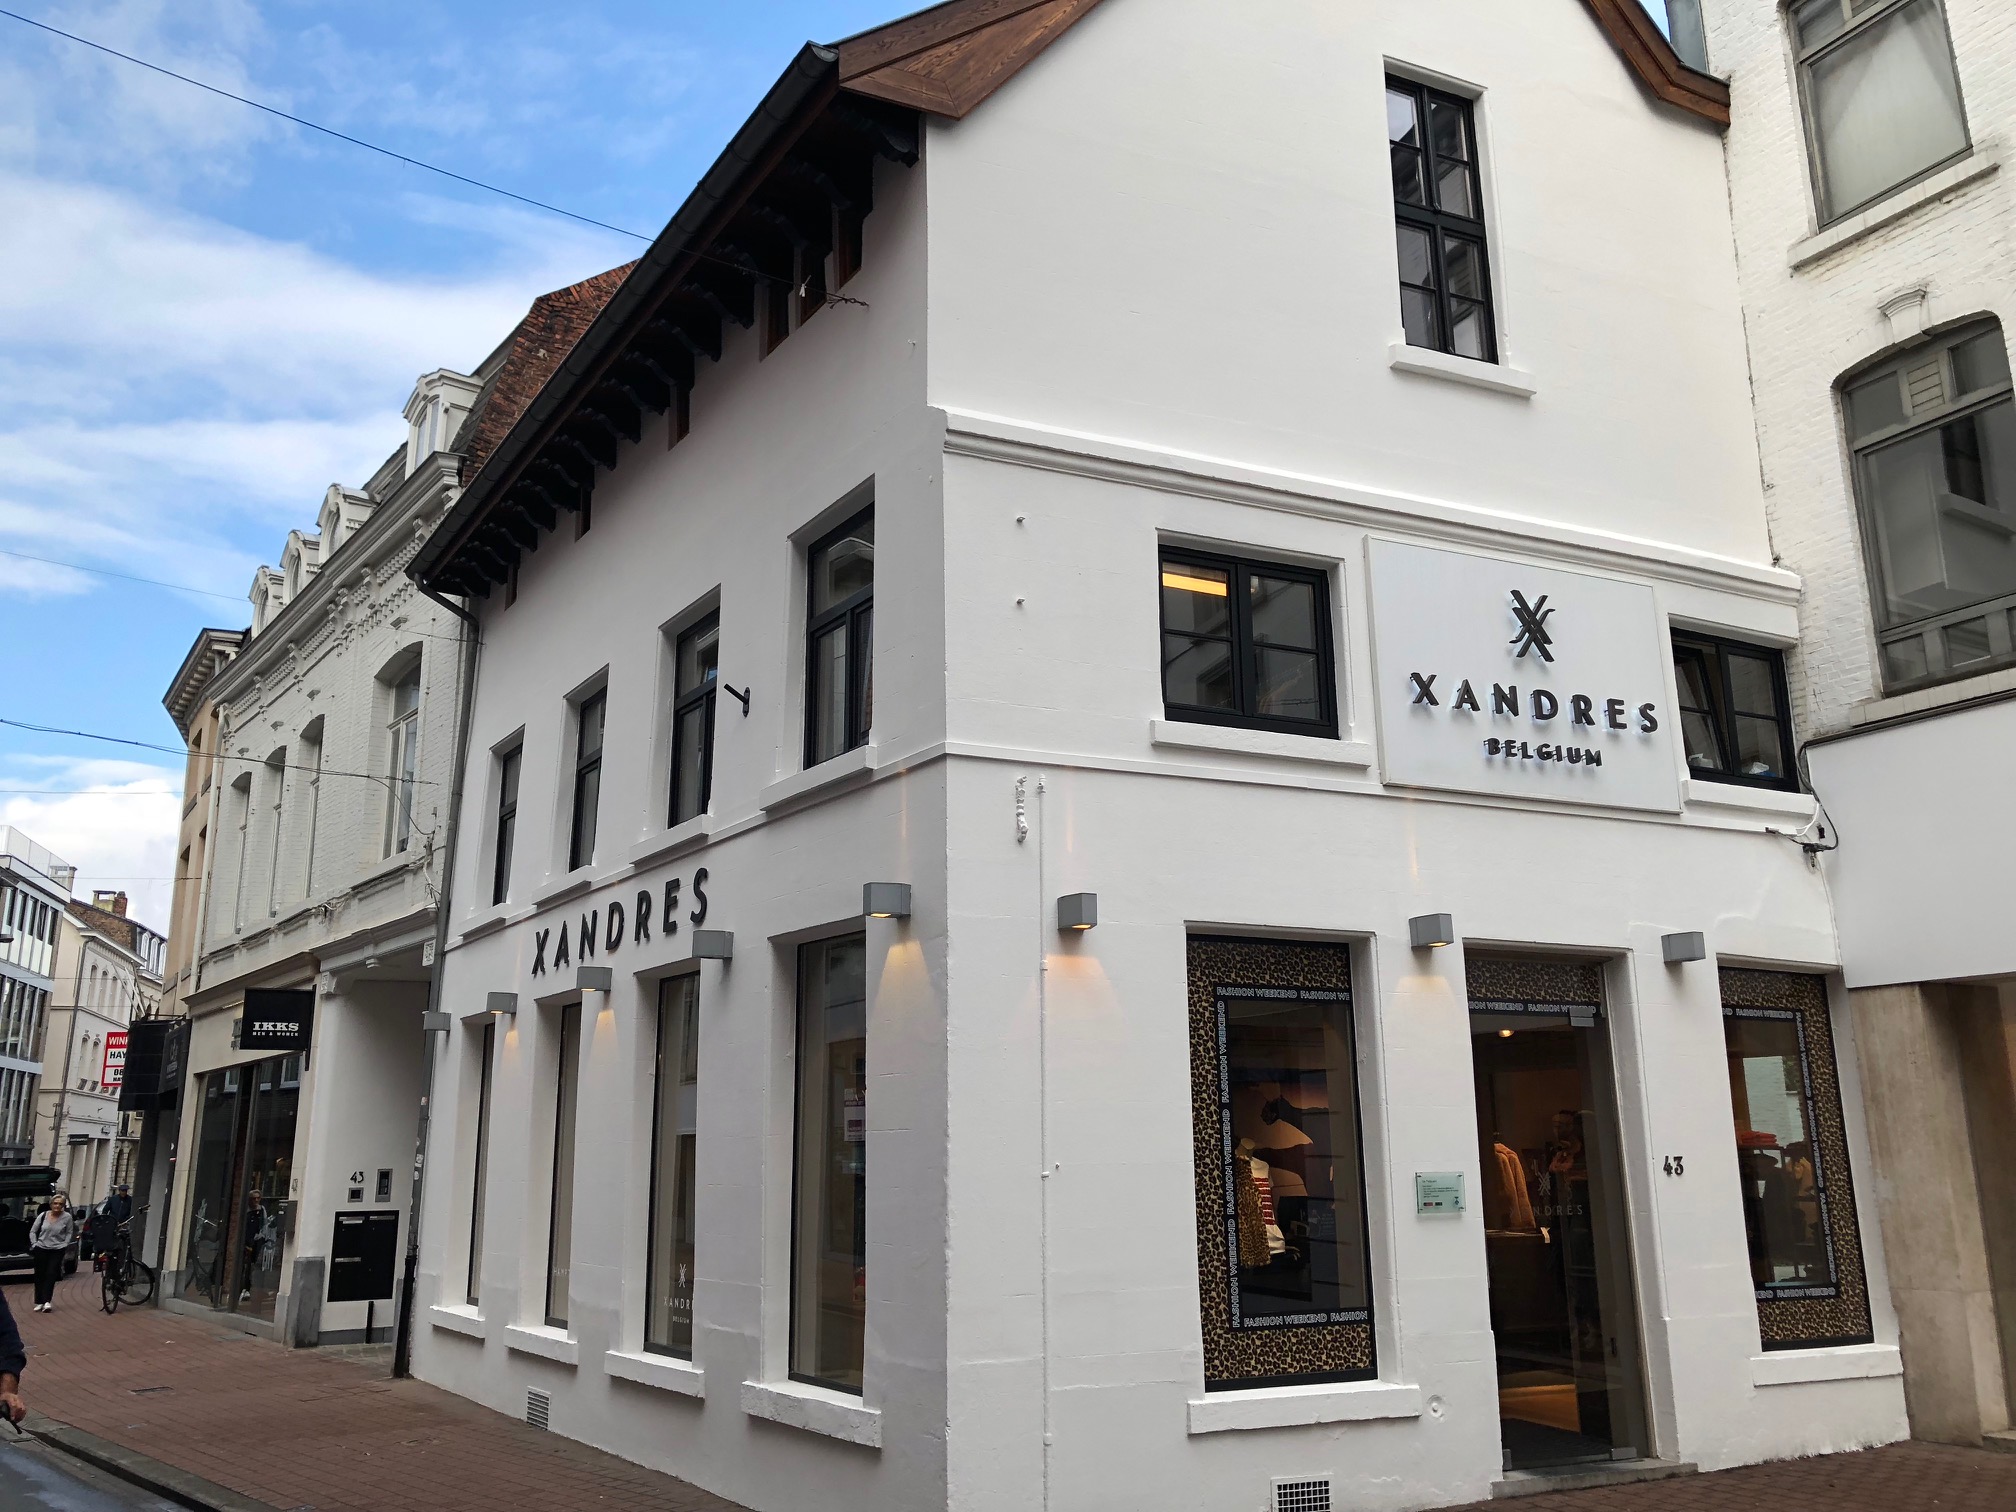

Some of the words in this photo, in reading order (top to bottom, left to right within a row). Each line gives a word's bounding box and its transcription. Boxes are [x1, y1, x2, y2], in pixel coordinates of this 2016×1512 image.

[1409, 672, 1658, 733] XANDRES
[1485, 737, 1603, 767] BELGIUM
[531, 867, 708, 976] XANDRES
[1216, 986, 1254, 997] FASHION
[1255, 988, 1298, 999] WEEKEND
[1300, 990, 1337, 1000] FASHION
[1486, 1001, 1524, 1011] WEEKEND
[1527, 1003, 1561, 1013] FASHION
[252, 1021, 299, 1032] IKKS
[1217, 1000, 1227, 1055] WEEKEND
[1219, 1055, 1230, 1104] FASHION
[1222, 1108, 1232, 1165] WEEKEND
[349, 1171, 365, 1184] 43
[1663, 1155, 1684, 1177] 43
[1225, 1165, 1235, 1215] FASHION
[1227, 1218, 1238, 1276] WEEKEND
[663, 1296, 691, 1310] XANDR
[1230, 1277, 1240, 1328] FASHION
[1243, 1316, 1283, 1327] FASHION
[1284, 1313, 1328, 1325] WEEKEND
[1330, 1310, 1368, 1322] FASHION
